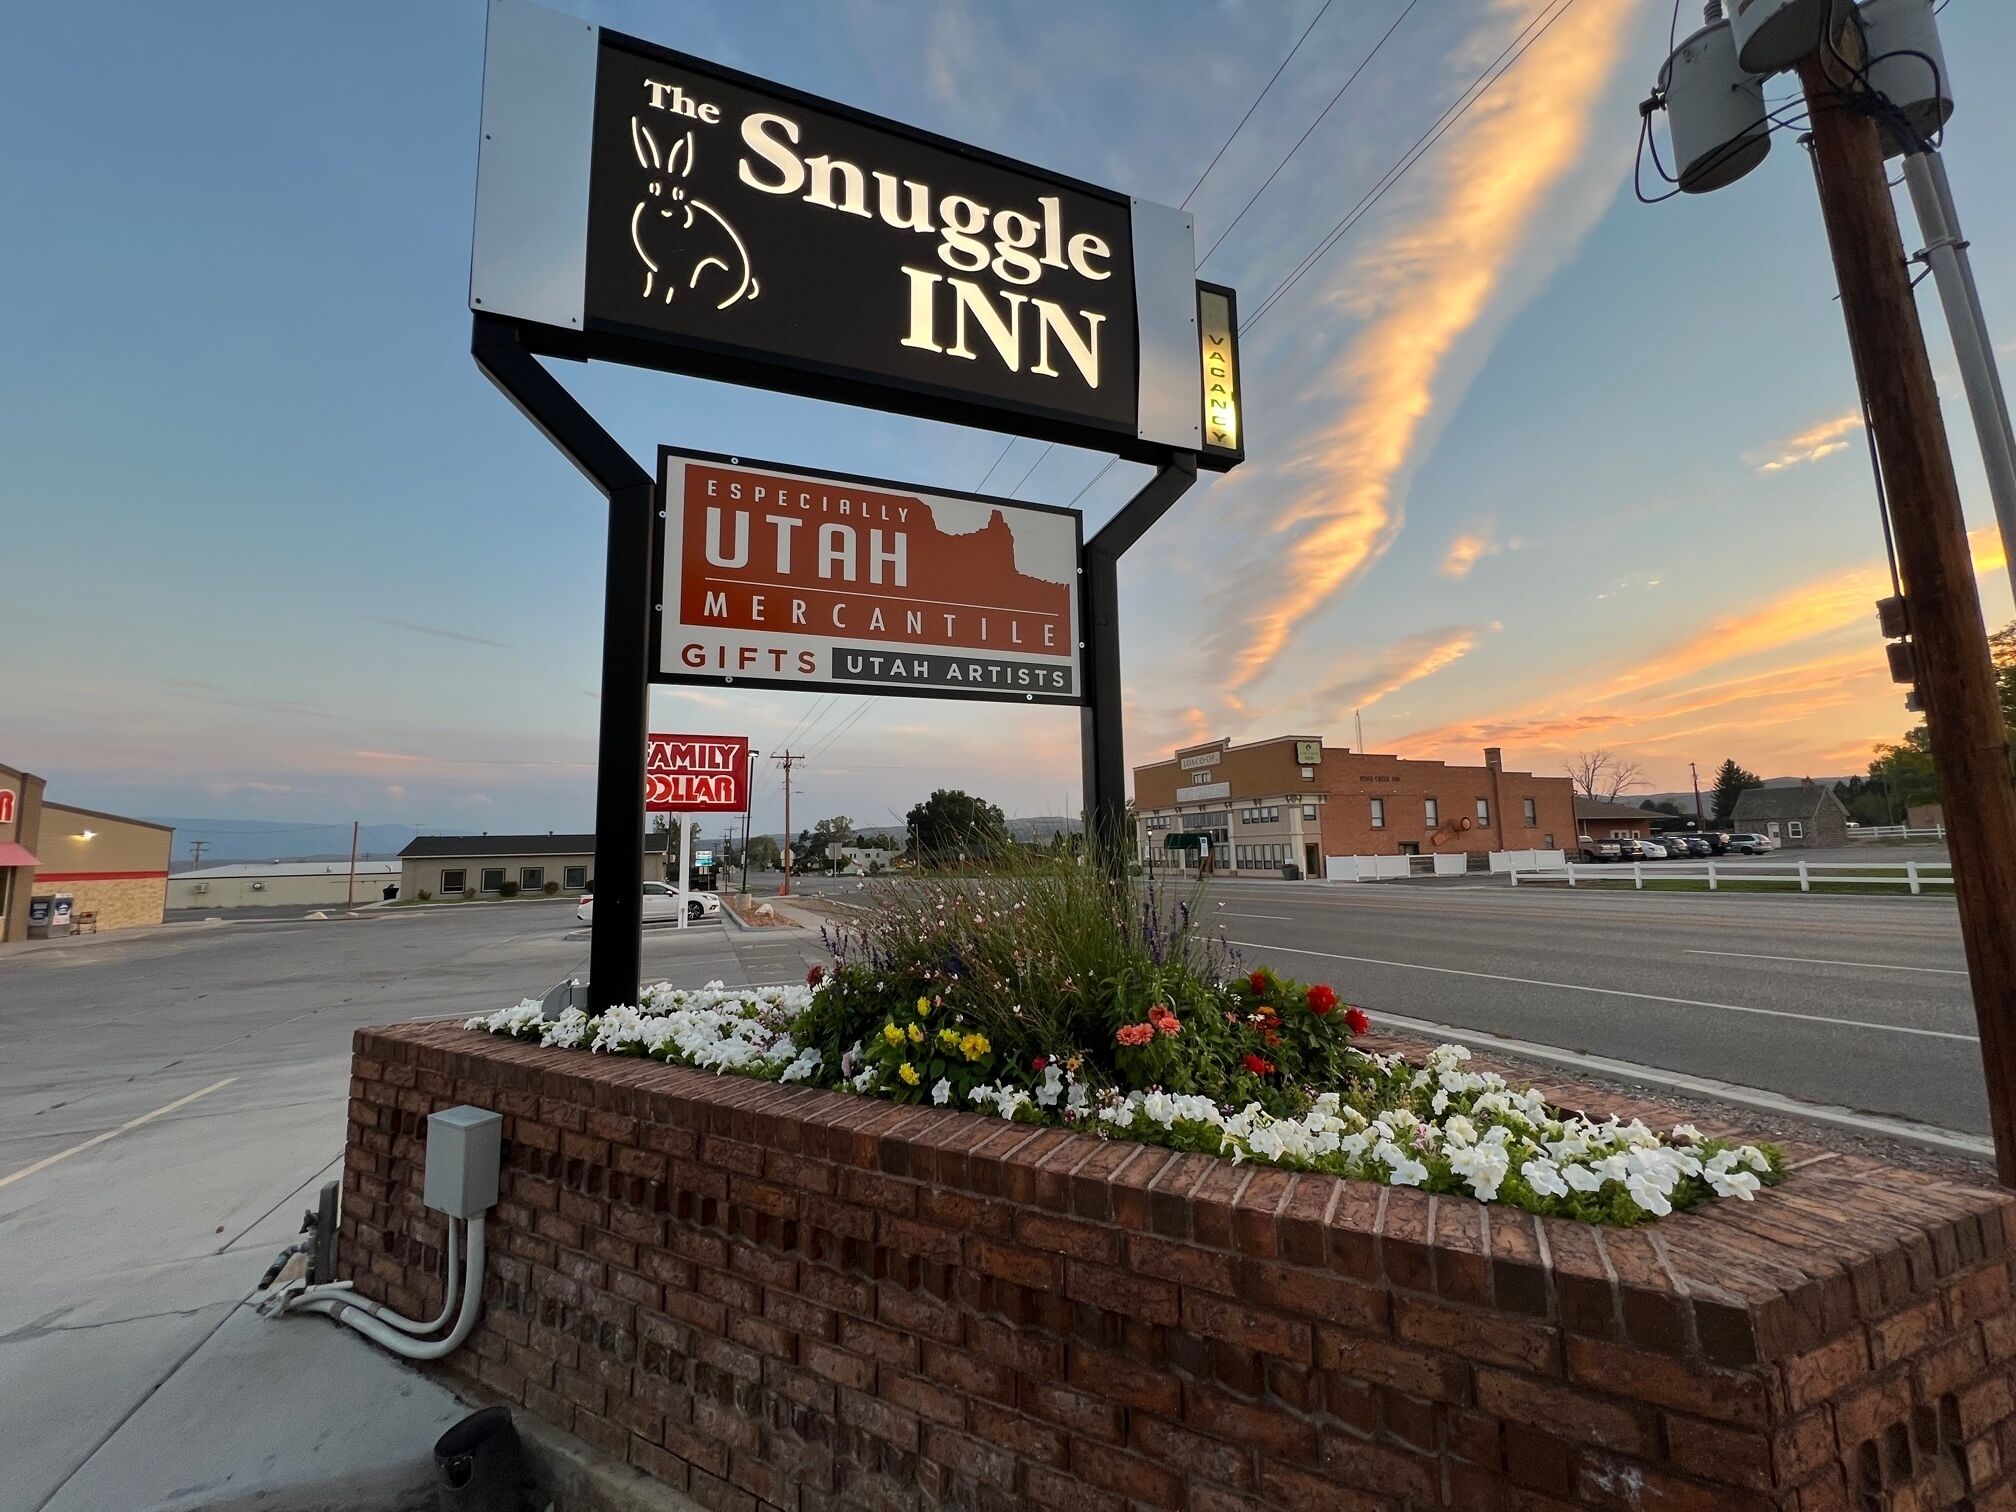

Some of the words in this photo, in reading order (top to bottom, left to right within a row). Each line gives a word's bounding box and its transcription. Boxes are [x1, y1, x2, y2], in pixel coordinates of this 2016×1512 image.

[643, 78, 720, 124] The
[738, 112, 1112, 285] Snuggle
[900, 265, 1107, 389] INN
[1208, 334, 1227, 443] VACANCY
[707, 479, 909, 523] ESPECIALLY
[705, 506, 908, 588] UTAH
[703, 590, 1056, 648] MERCANTILE
[681, 642, 817, 675] GIFTS
[846, 655, 929, 679] UTAH
[946, 662, 1065, 688] ARTISTS
[647, 741, 740, 771] AMILY
